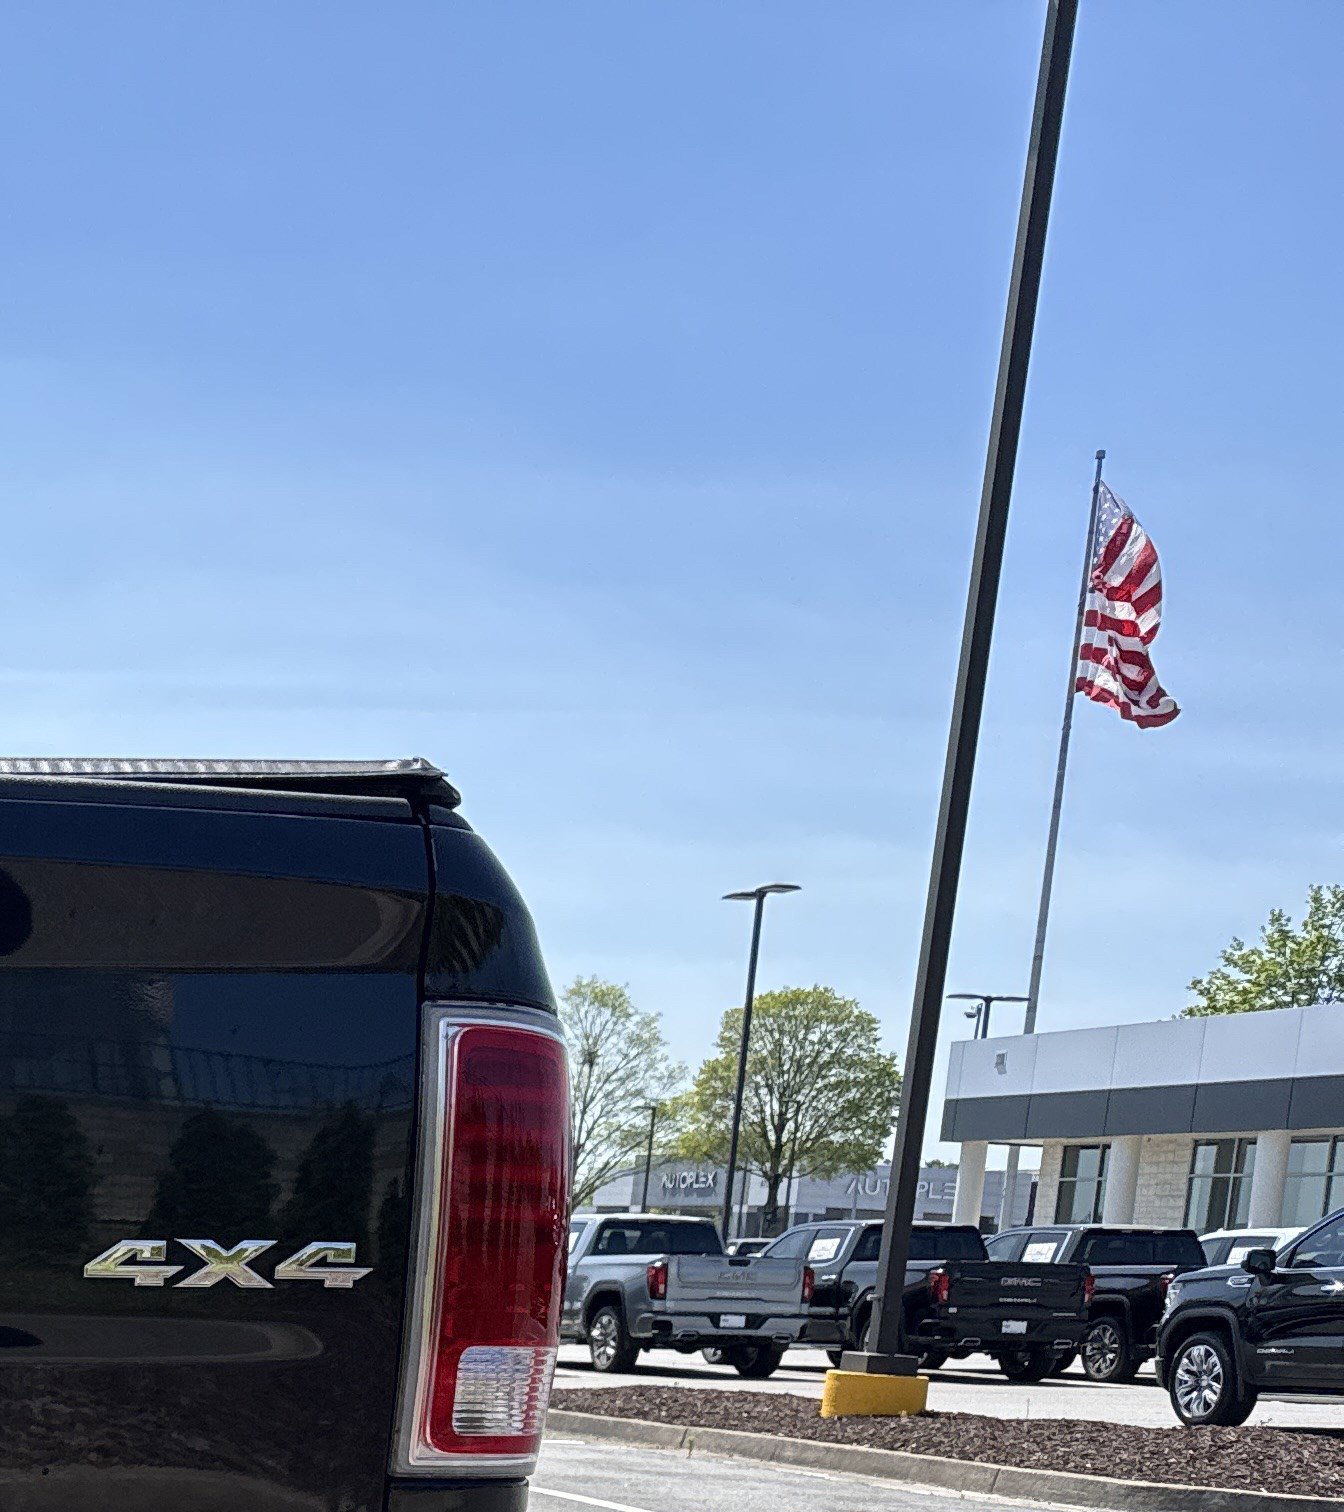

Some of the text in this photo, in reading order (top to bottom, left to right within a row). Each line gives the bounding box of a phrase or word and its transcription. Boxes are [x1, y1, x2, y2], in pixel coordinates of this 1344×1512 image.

[661, 1171, 717, 1189] AUTOPLEX
[846, 1177, 957, 1200] AUTPLE
[83, 1237, 373, 1289] 4X4
[1001, 1277, 1042, 1286] GMC
